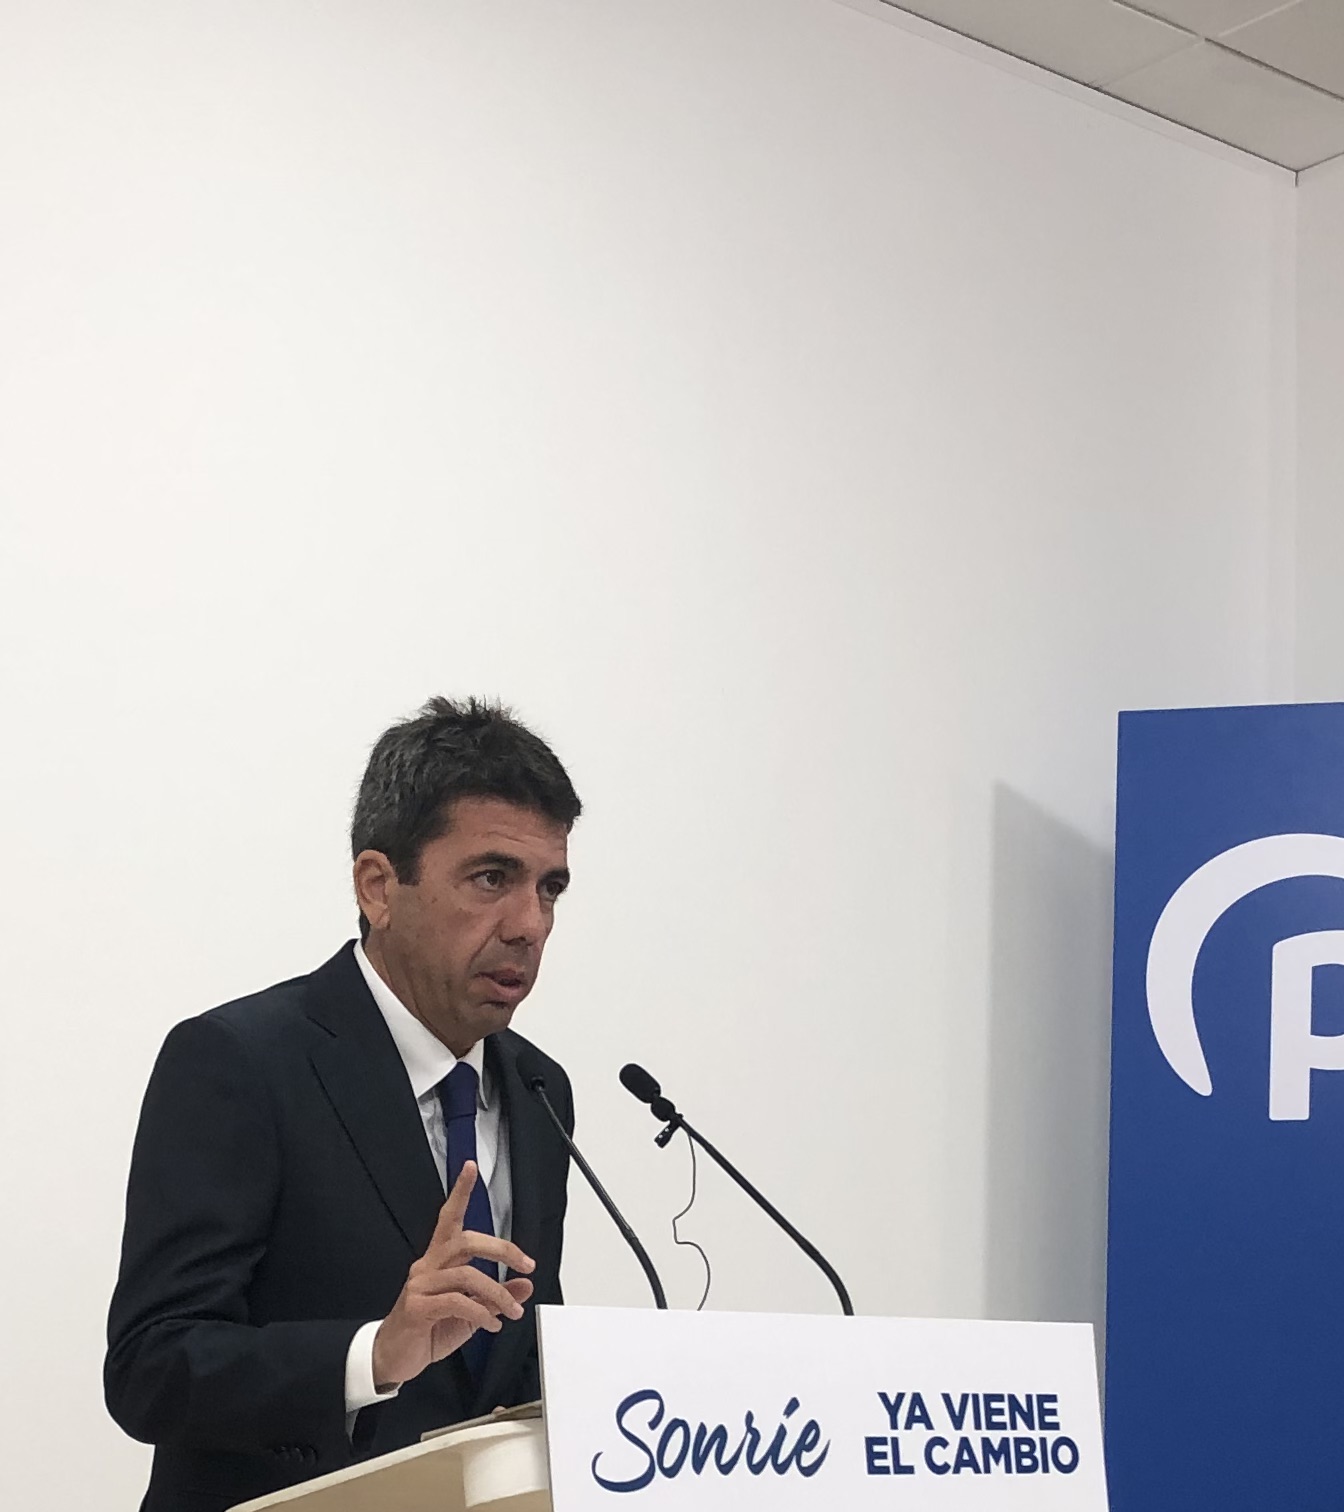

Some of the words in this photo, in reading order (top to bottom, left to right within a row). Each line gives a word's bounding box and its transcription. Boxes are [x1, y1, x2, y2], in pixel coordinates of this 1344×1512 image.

[877, 1391, 934, 1431] YA
[940, 1391, 1060, 1431] VIENE
[591, 1388, 832, 1493] Sonríe
[864, 1436, 915, 1476] EL
[923, 1436, 1080, 1475] CAMBIO
